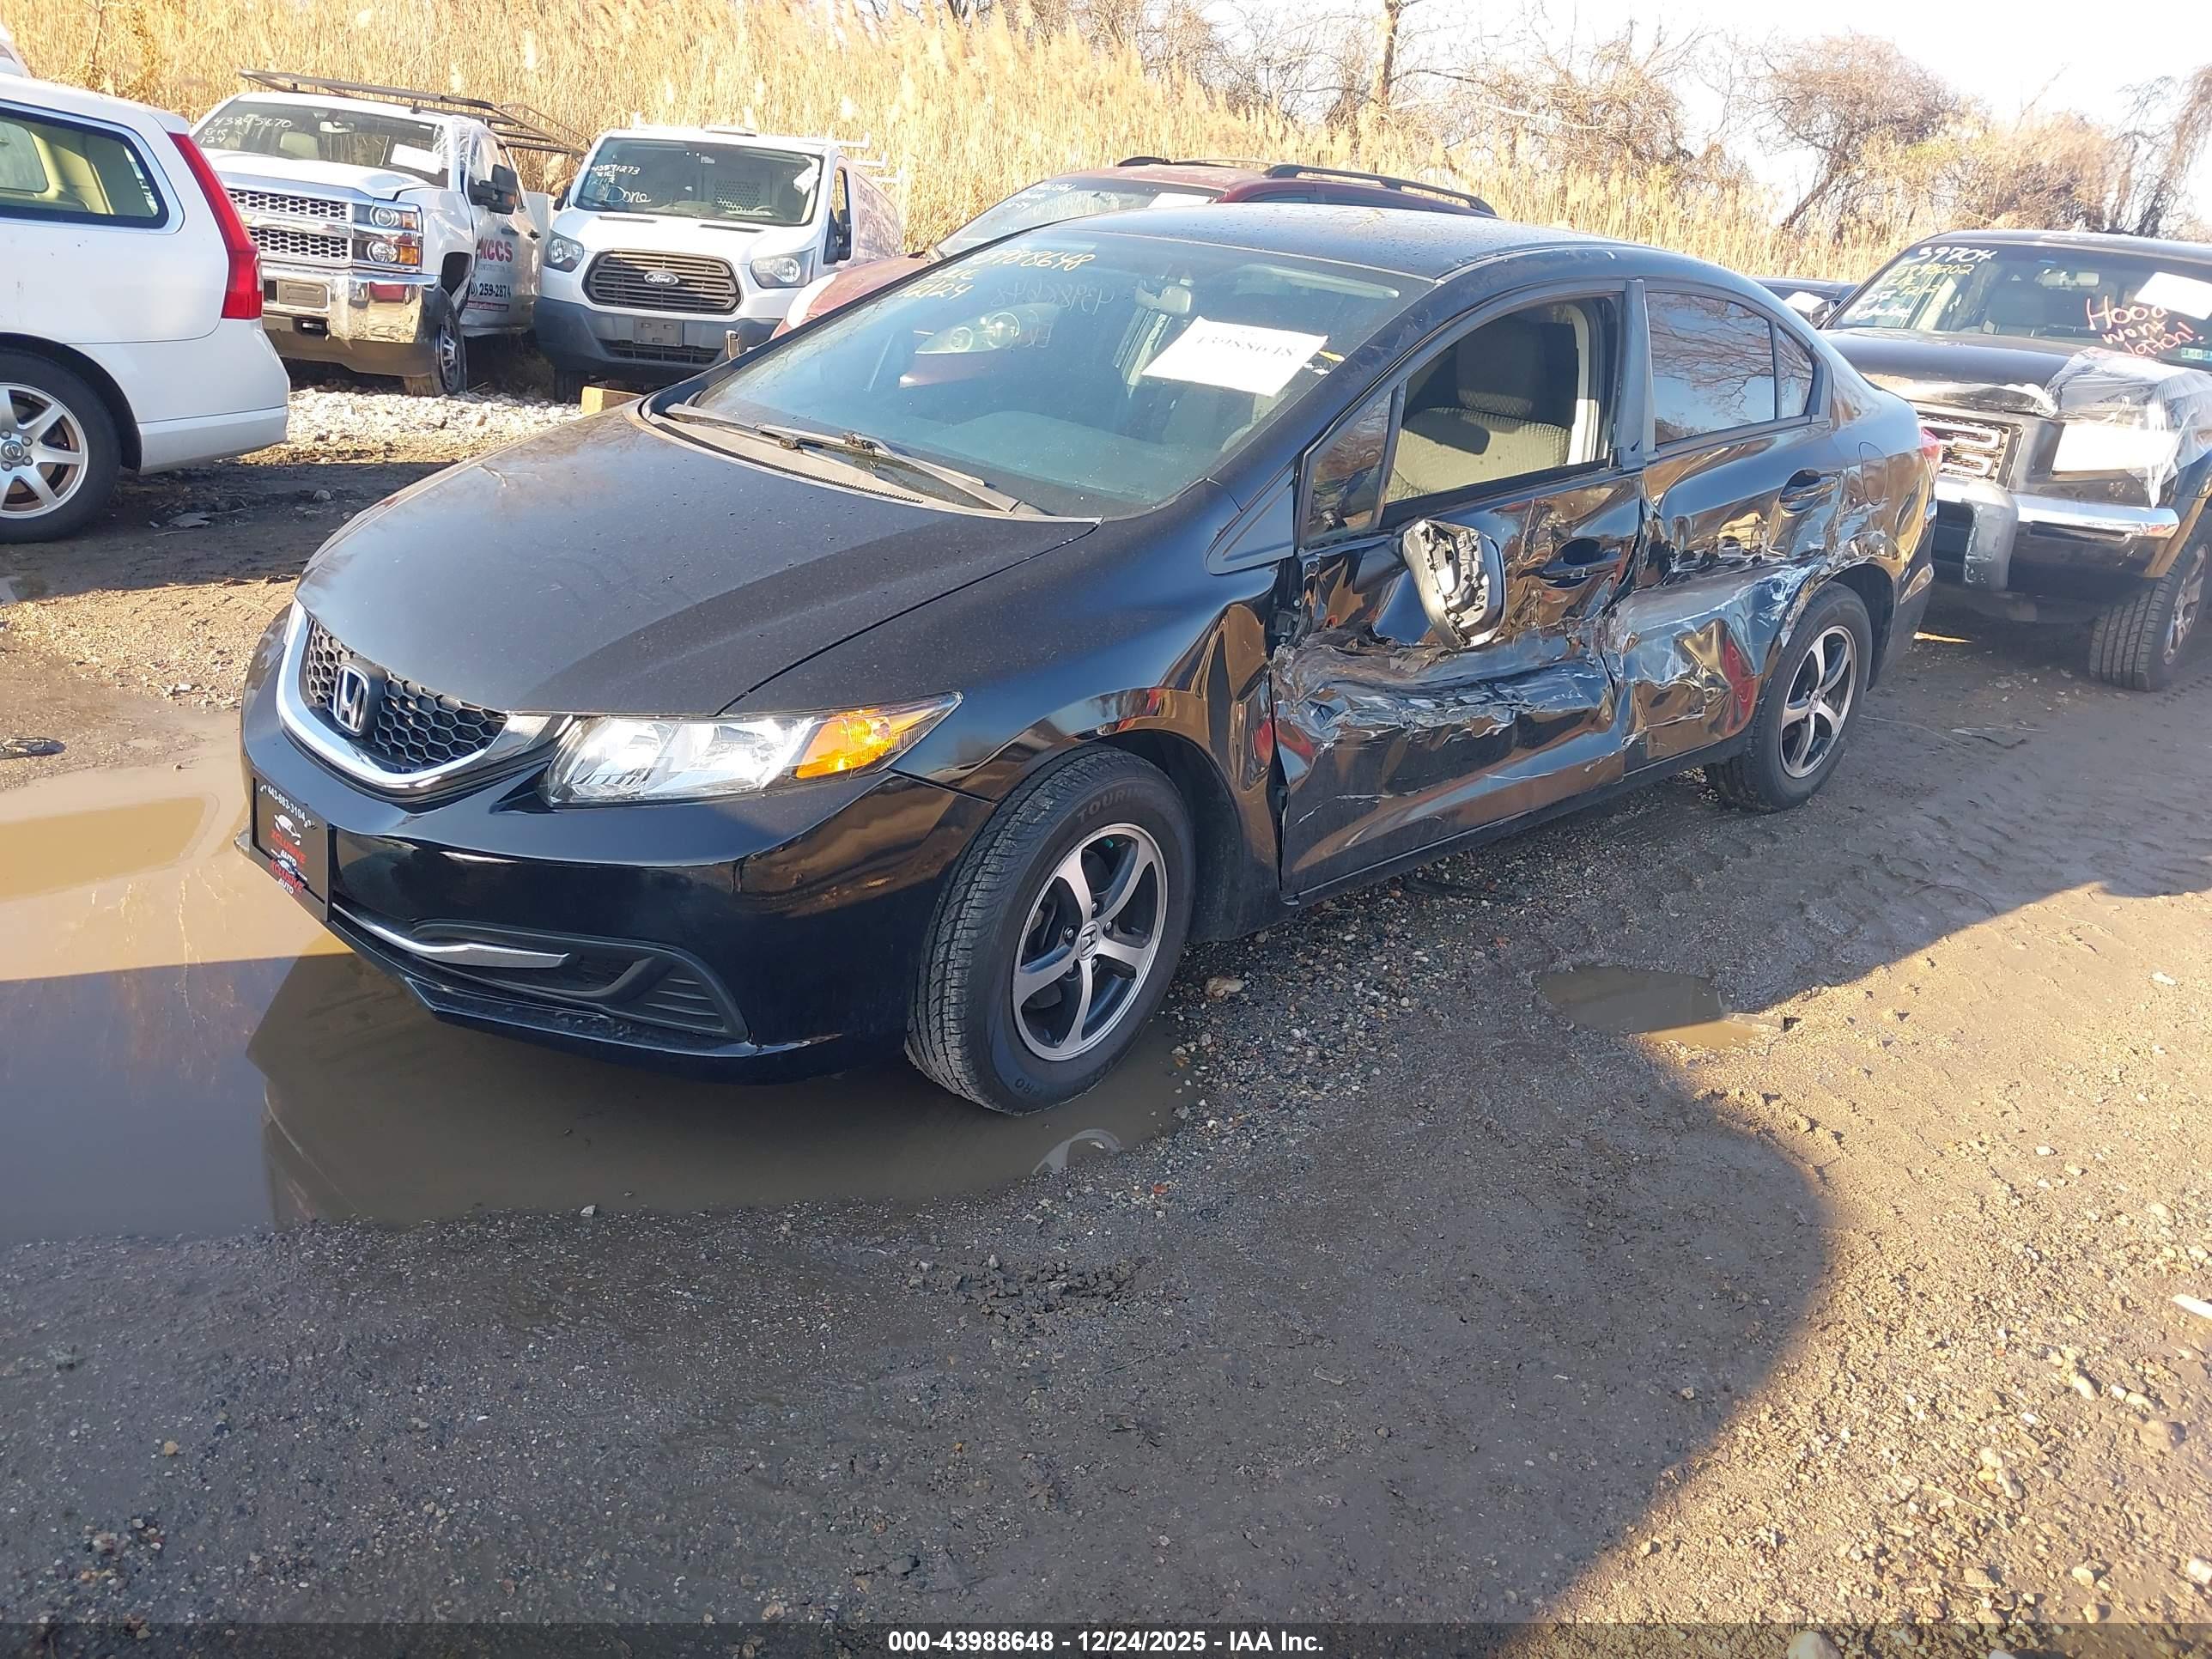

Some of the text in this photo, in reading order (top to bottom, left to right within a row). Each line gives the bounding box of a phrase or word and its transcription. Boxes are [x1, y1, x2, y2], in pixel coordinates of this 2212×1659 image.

[605, 185, 652, 203] Done
[280, 849, 297, 866] AUTO
[277, 878, 294, 894] AUTO
